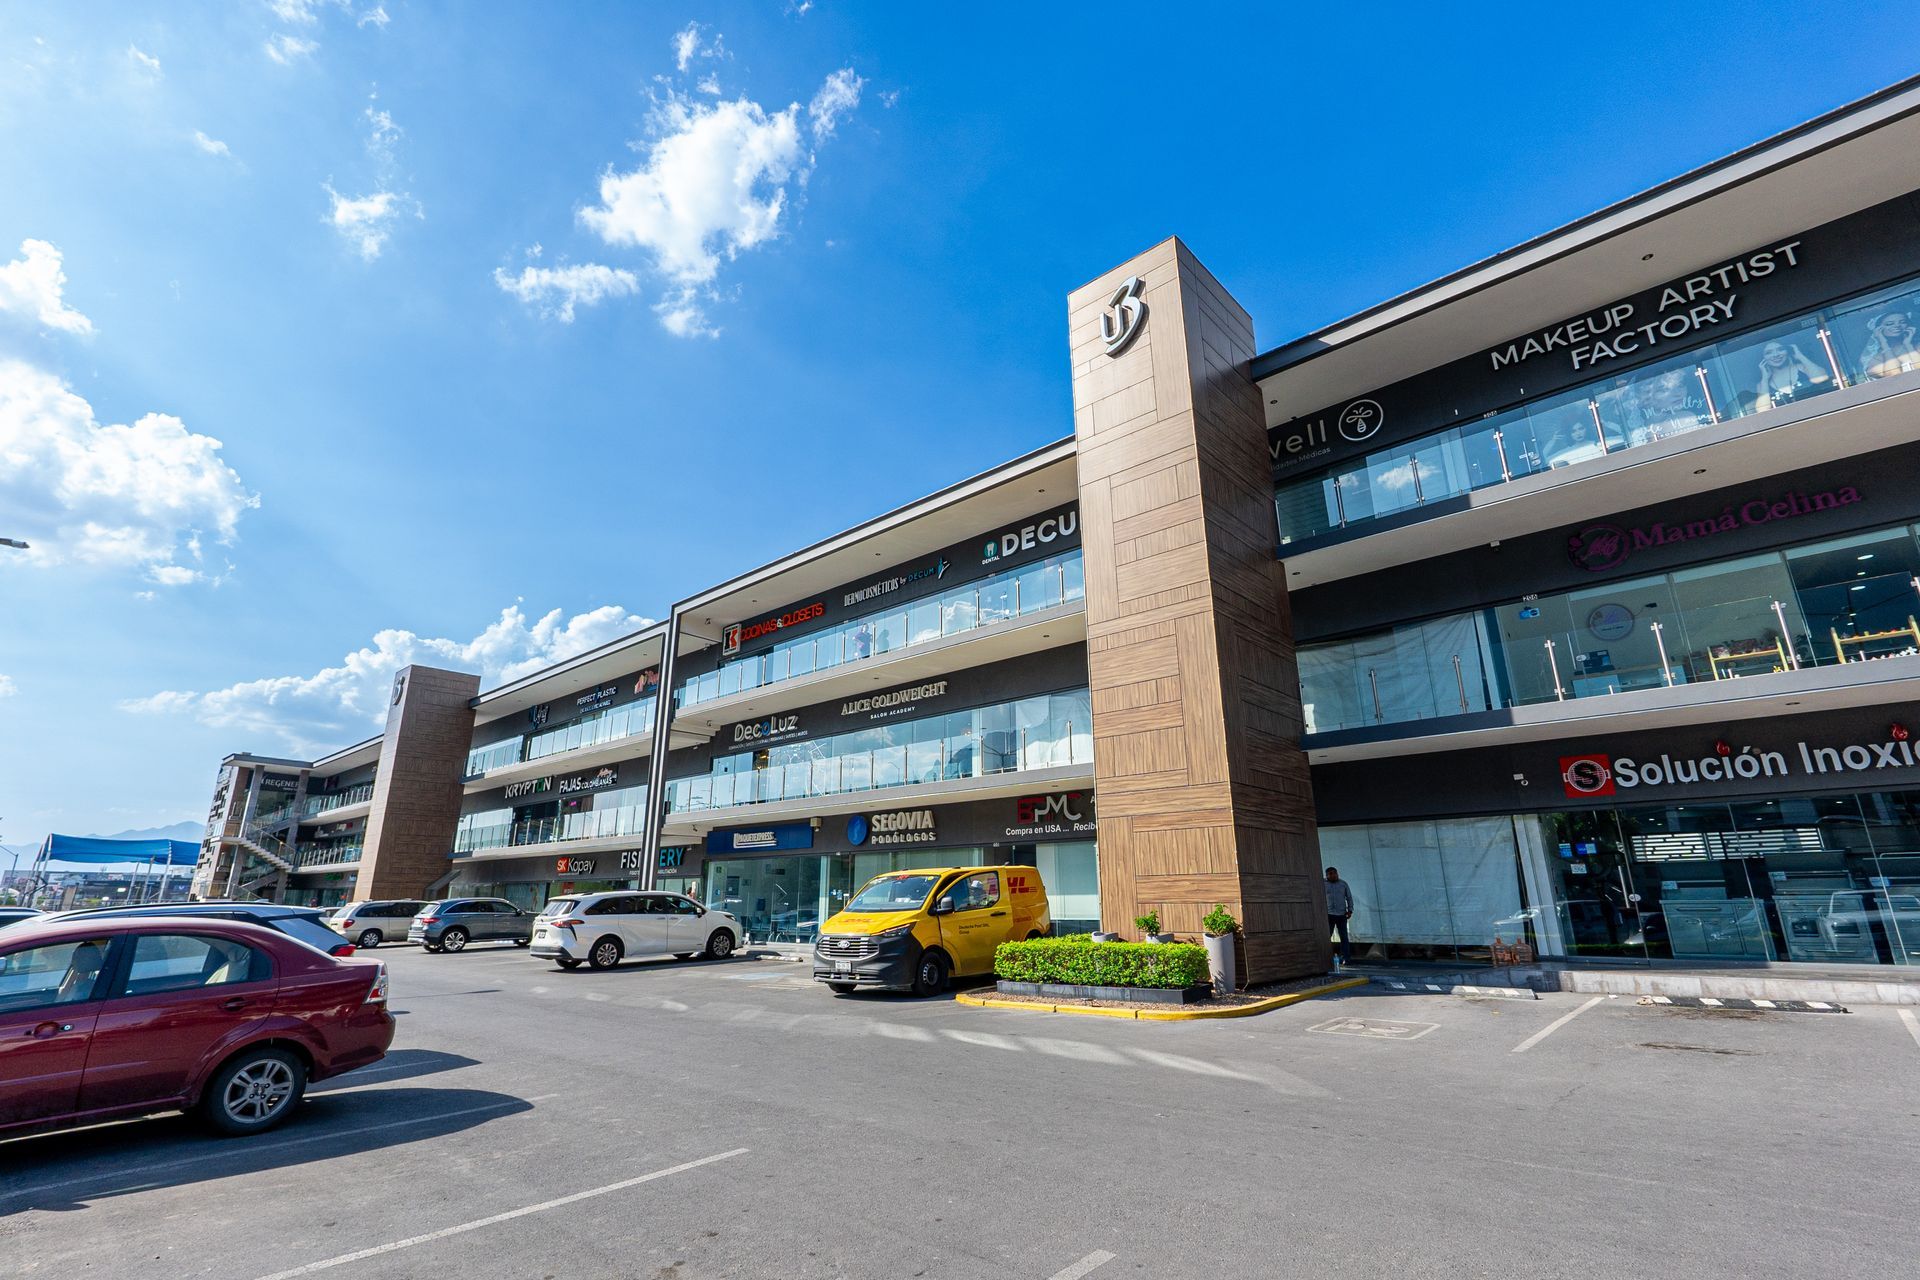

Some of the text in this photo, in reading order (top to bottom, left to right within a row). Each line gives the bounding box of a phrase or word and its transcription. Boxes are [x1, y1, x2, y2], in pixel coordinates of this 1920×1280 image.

[1490, 240, 1801, 371] MAKEUP ARTIST
[1571, 294, 1738, 370] FACTORY
[1631, 485, 1863, 551] Mamá Celina
[1001, 511, 1077, 557] DECU
[843, 577, 899, 607] DERMOCOSMÉTICOS
[597, 686, 617, 699] PLASTIC
[840, 680, 949, 716] ALICE GOLDWEIGHT
[870, 706, 916, 720] SALON ACADEMY
[1613, 746, 1789, 788] Solución
[504, 776, 552, 799] KRYPTON
[559, 776, 582, 794] FAJAS
[871, 810, 936, 832] SEGOVIA
[1005, 827, 1033, 836] Compra
[1034, 826, 1043, 834] en
[1044, 824, 1062, 833] USA
[871, 831, 937, 845] PODÓLOGOS
